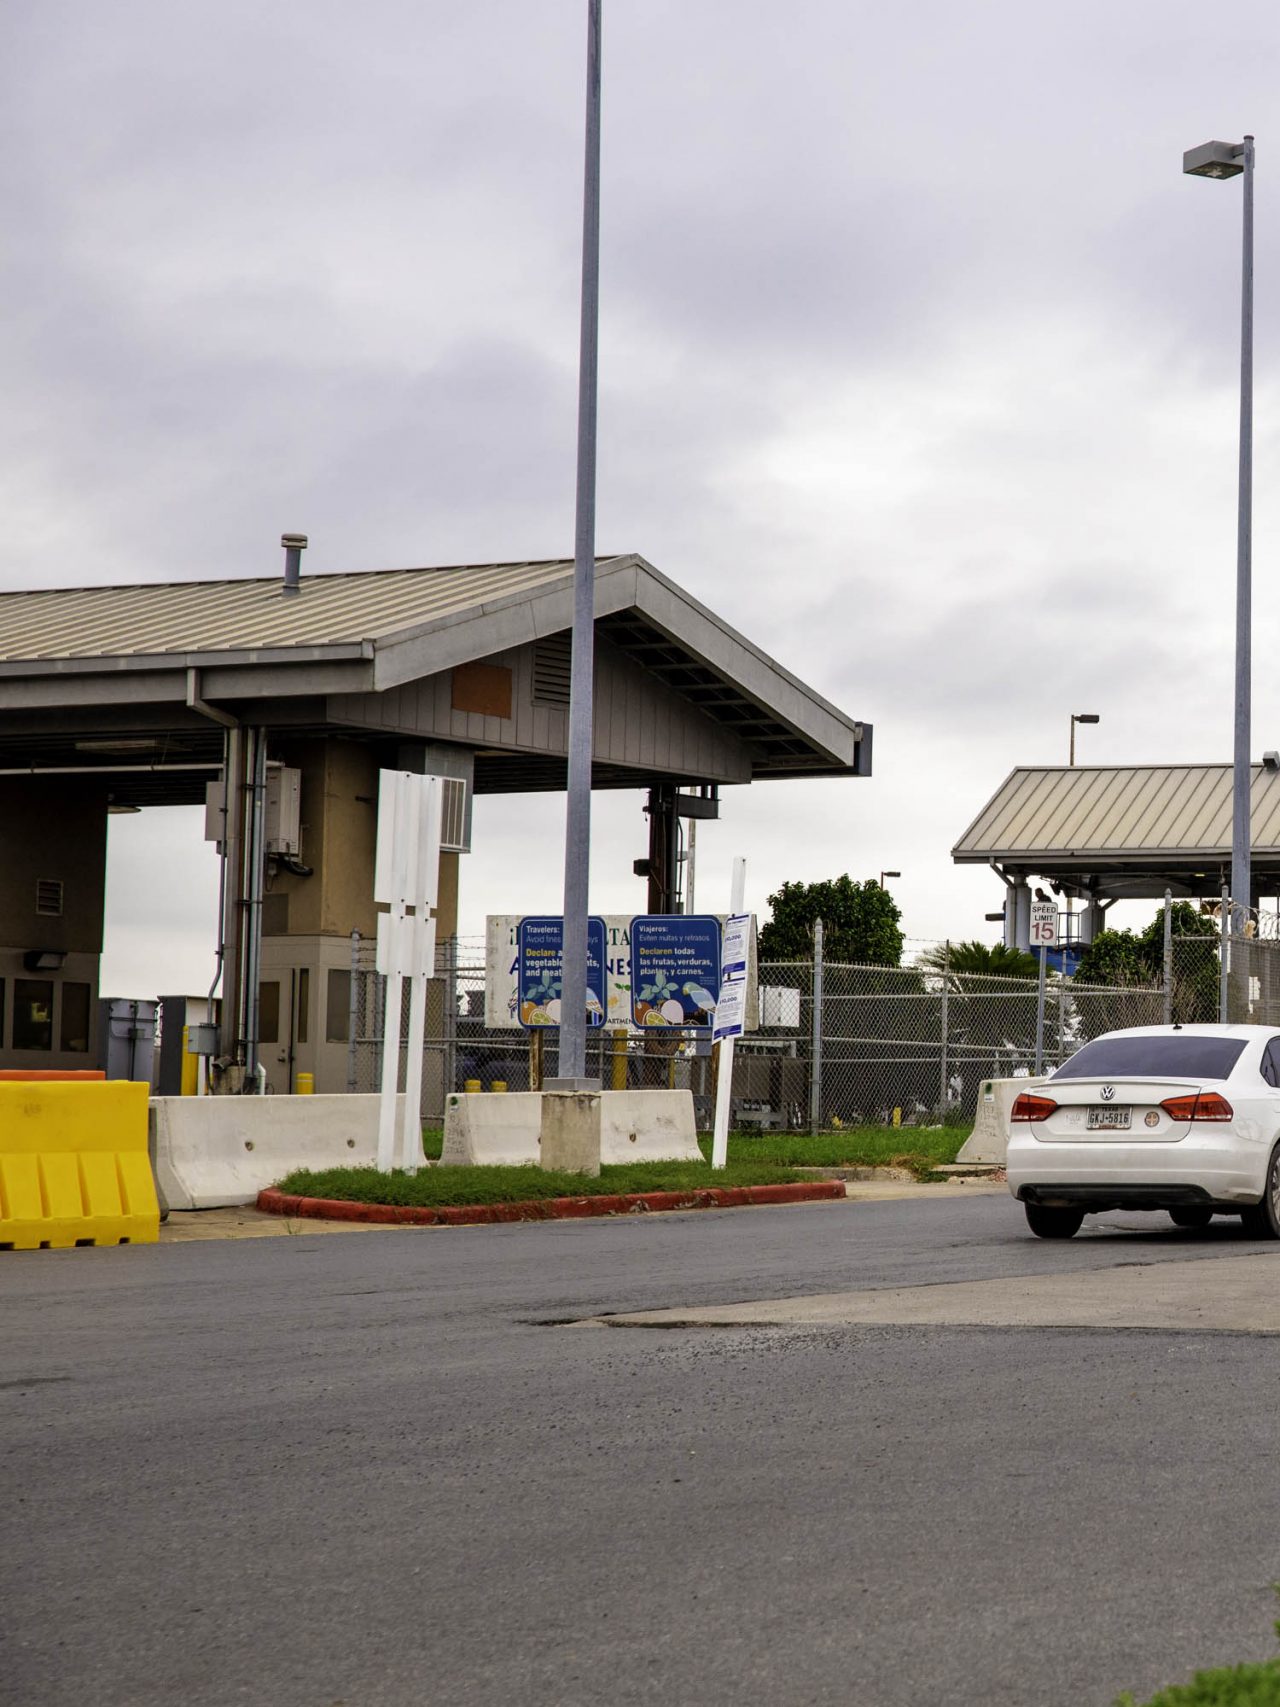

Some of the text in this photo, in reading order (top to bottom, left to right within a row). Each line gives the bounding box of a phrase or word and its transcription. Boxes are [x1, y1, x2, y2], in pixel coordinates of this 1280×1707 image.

[526, 925, 560, 934] Travelers:
[639, 925, 668, 934] Viajeros:
[1032, 922, 1054, 940] 15
[526, 935, 545, 943] Avoid
[526, 948, 556, 957] Declare
[525, 959, 563, 968] vegetable
[652, 958, 677, 967] frutas,
[677, 958, 713, 967] verduras,
[676, 968, 704, 976] carnes.
